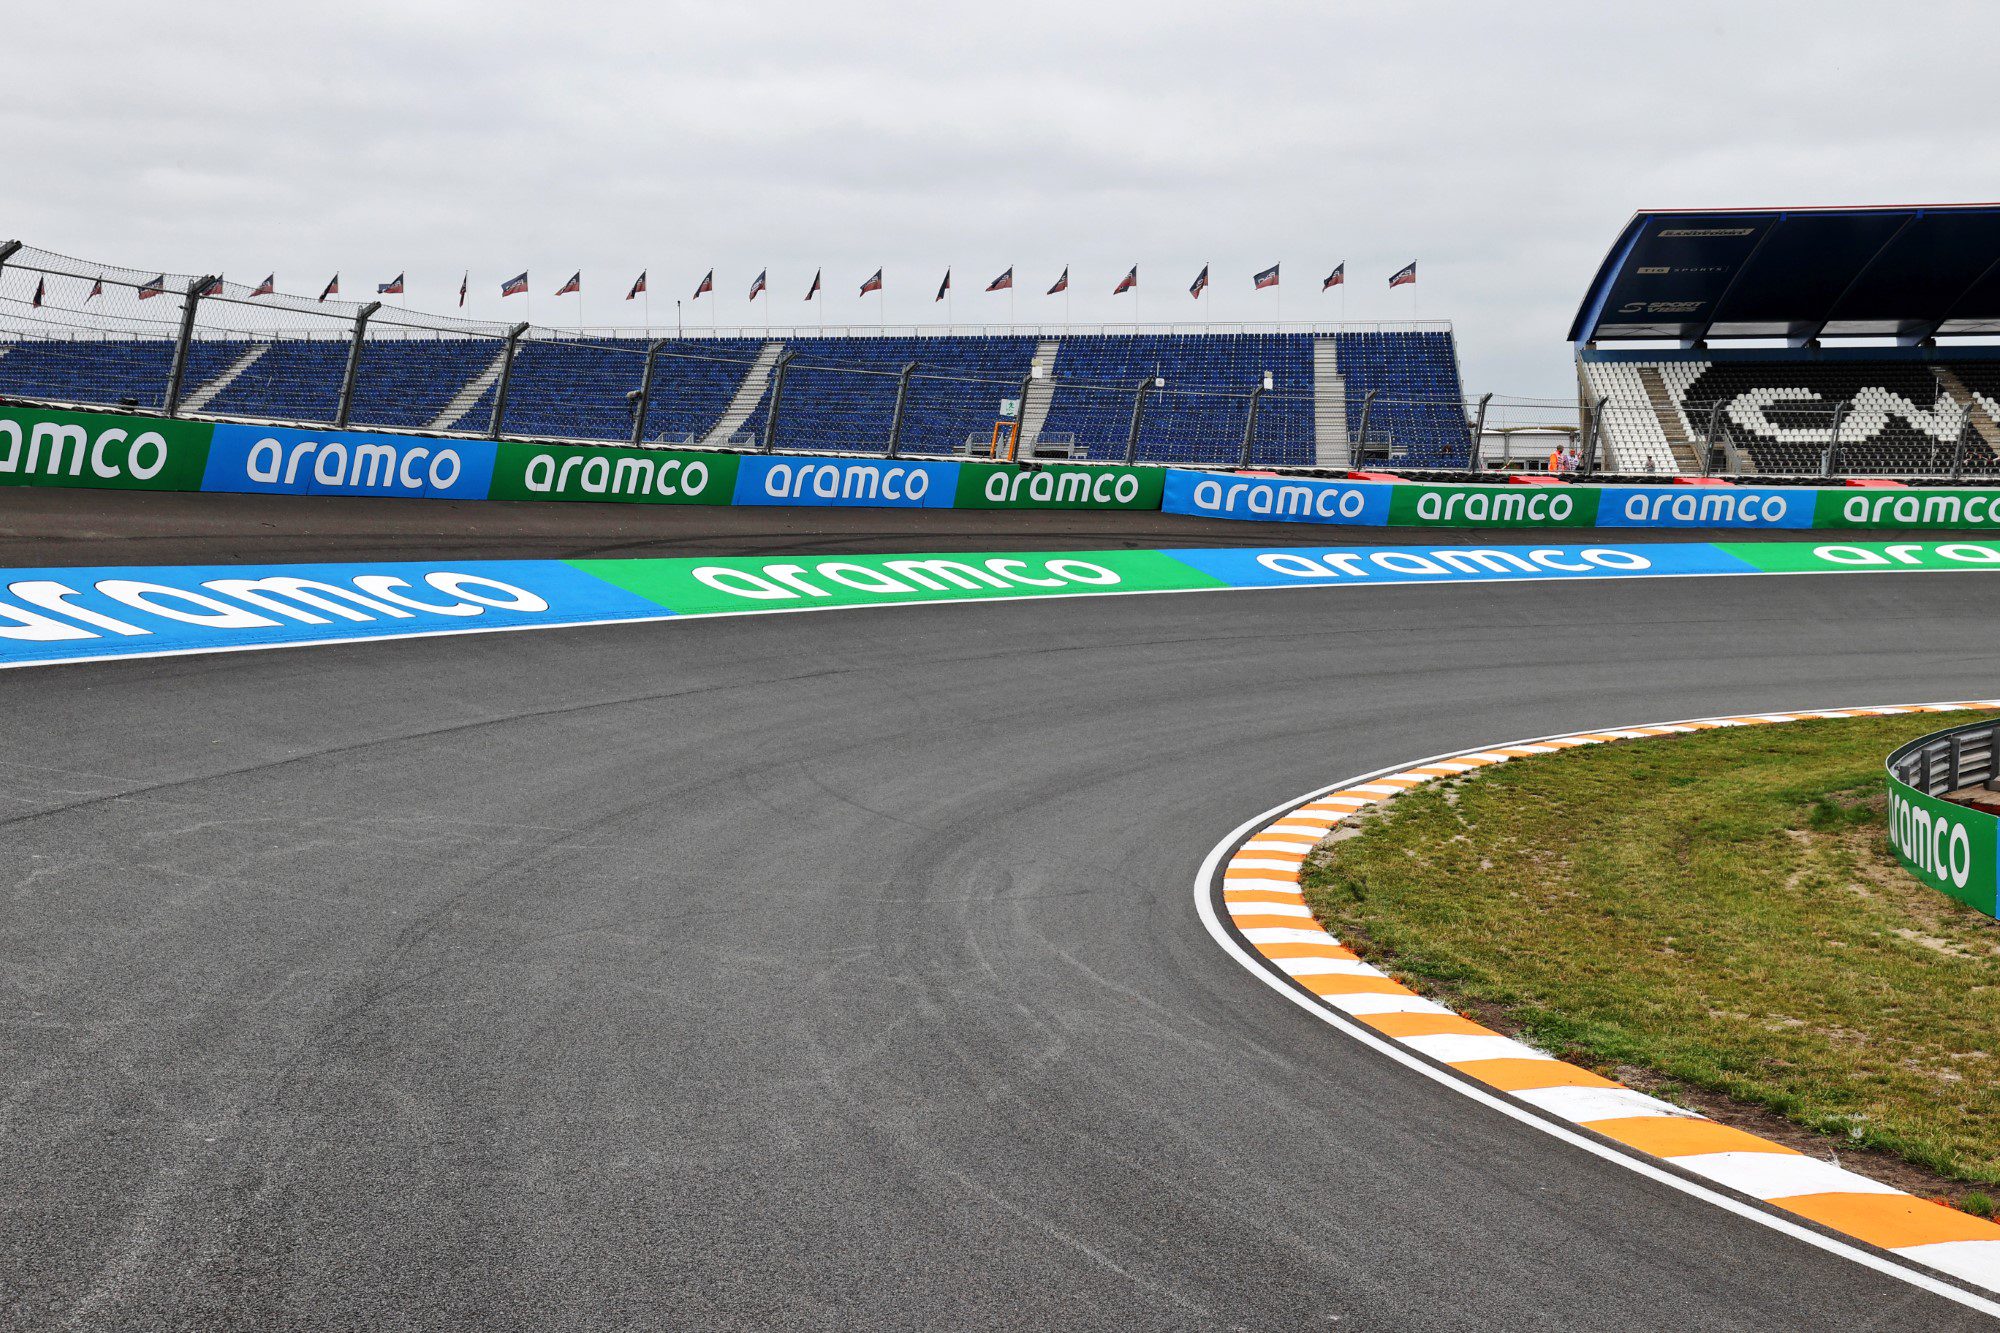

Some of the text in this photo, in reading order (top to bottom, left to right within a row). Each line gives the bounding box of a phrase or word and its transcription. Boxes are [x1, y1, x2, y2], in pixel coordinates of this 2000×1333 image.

[247, 439, 461, 490] aramco
[525, 455, 709, 496] aramco
[766, 465, 929, 500] aramco
[986, 472, 1139, 502] aramco
[1194, 481, 1365, 518] aramco
[1418, 493, 1573, 520] aramco
[1626, 495, 1787, 521] aramco
[692, 559, 1122, 600] aramco
[1257, 549, 1652, 577] aramco
[1888, 786, 1970, 889] aramco
